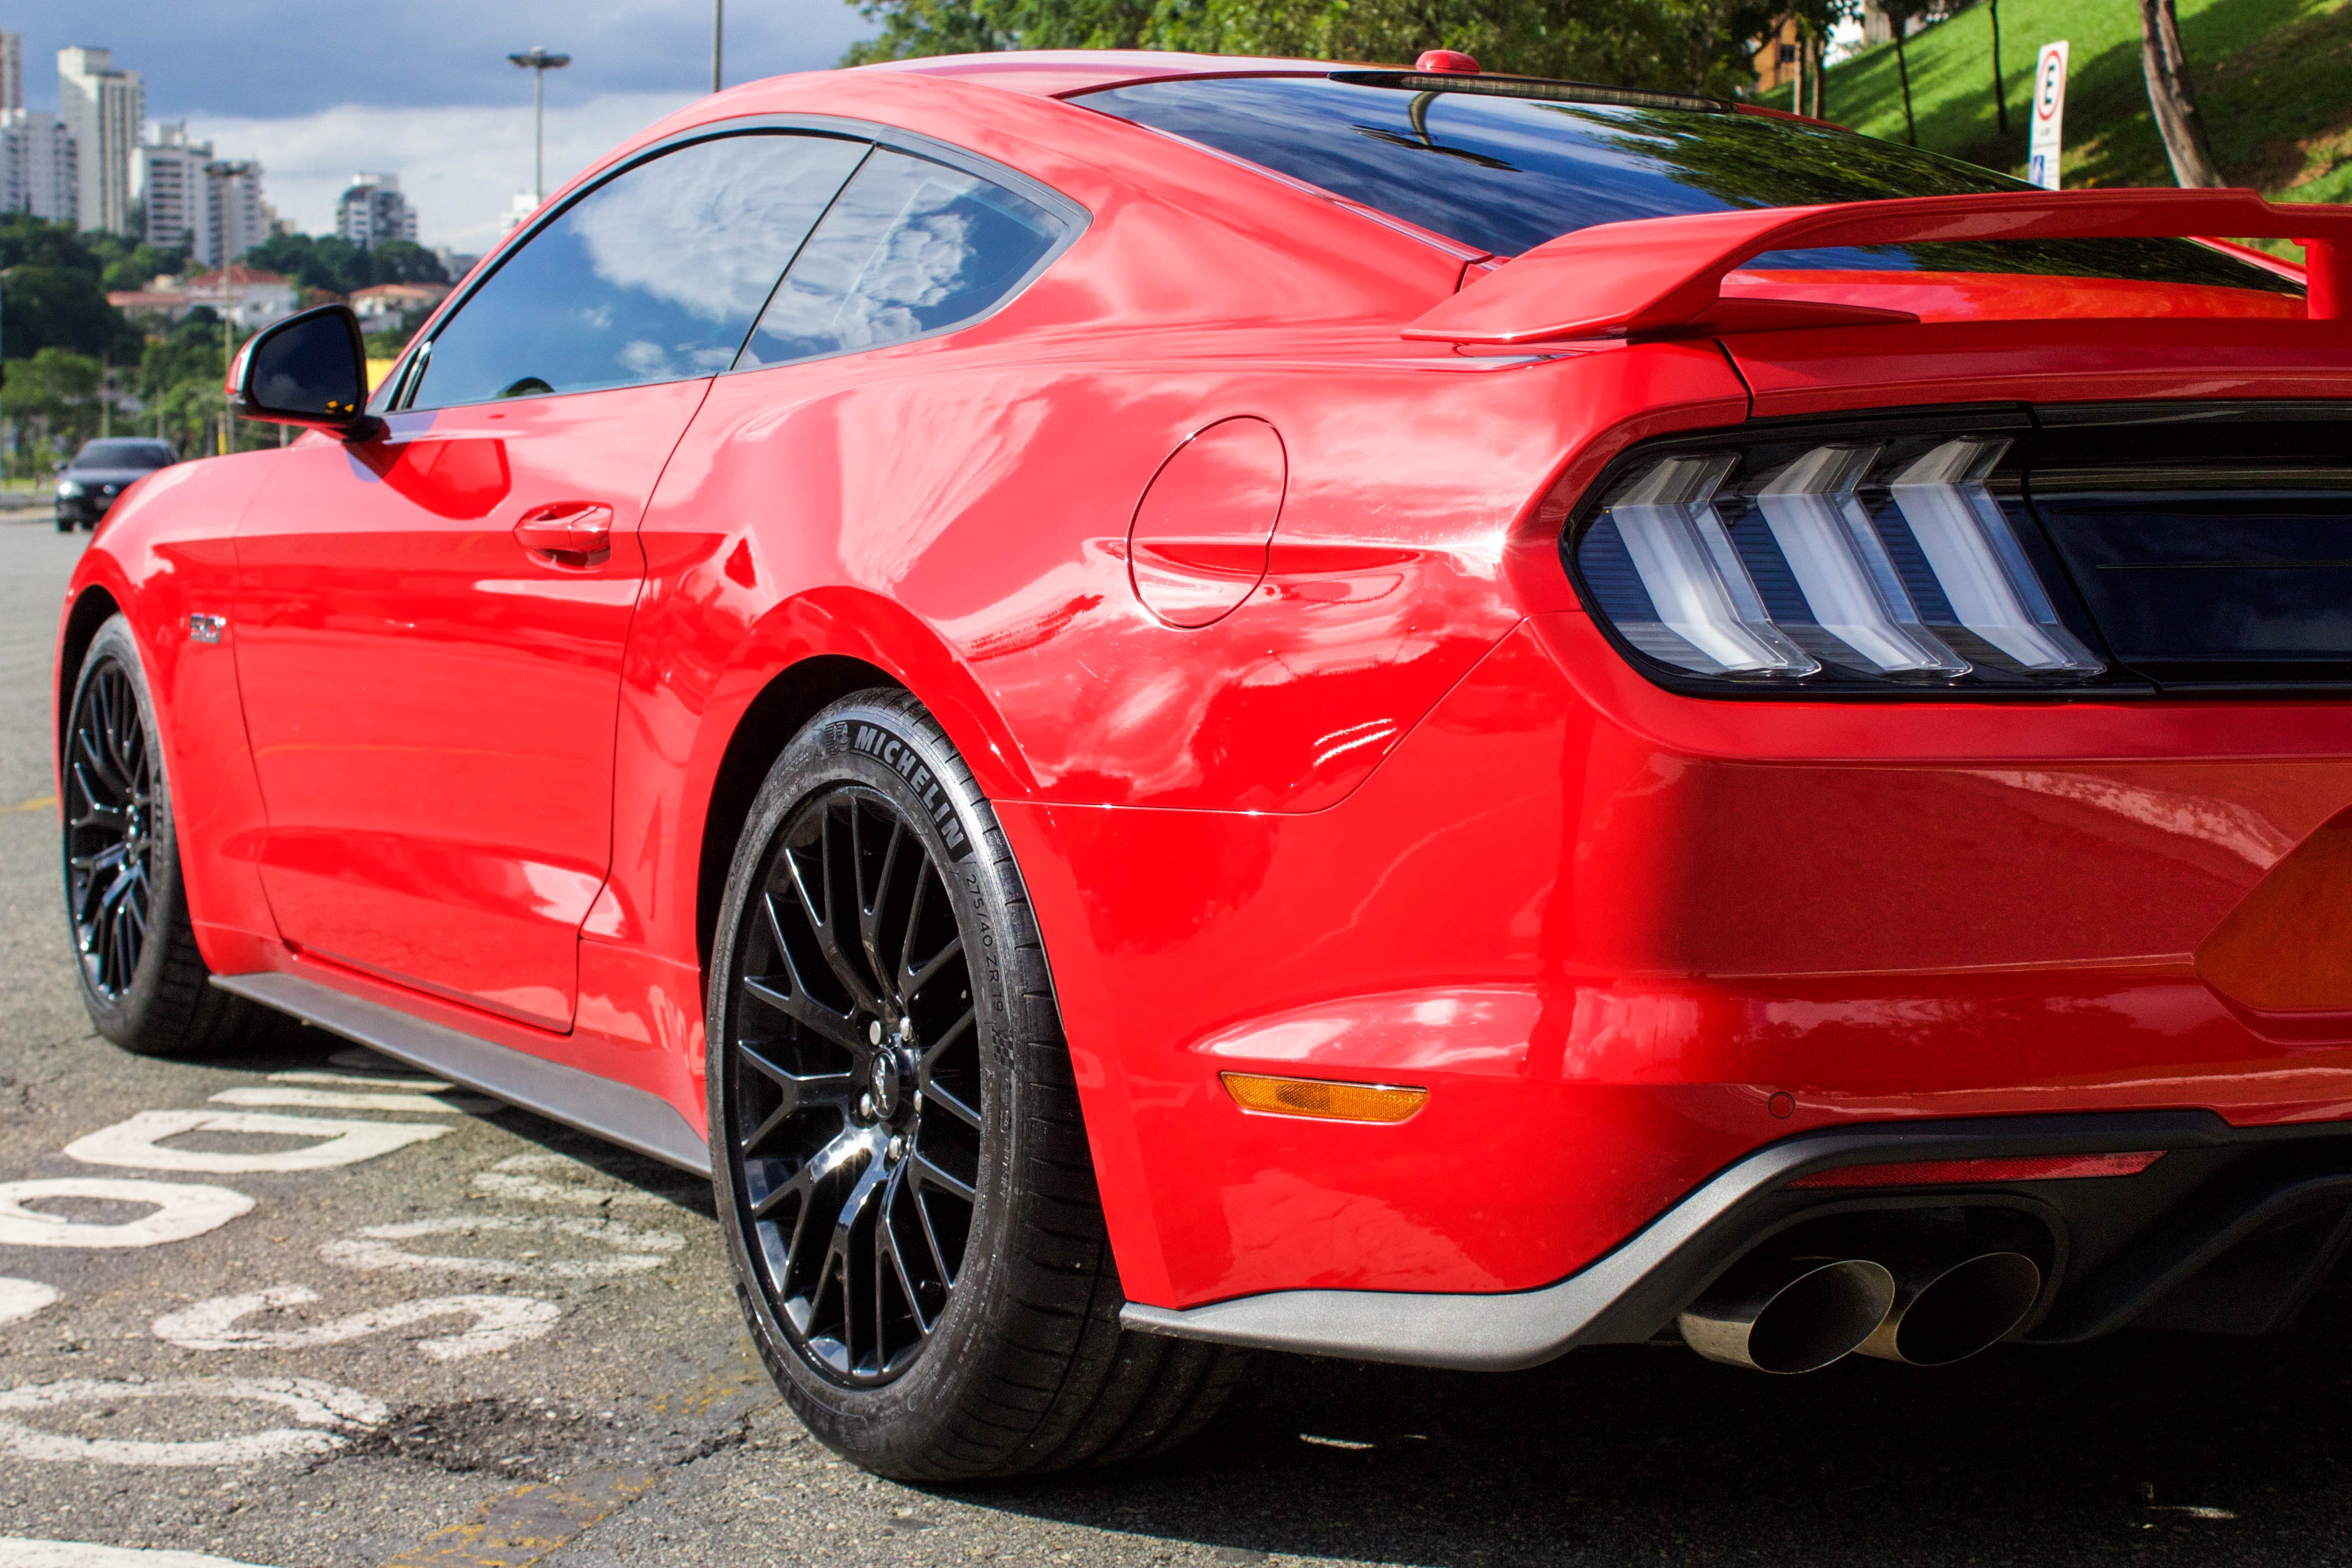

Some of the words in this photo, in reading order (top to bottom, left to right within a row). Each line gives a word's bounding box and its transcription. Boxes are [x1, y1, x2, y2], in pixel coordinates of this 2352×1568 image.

[2045, 65, 2056, 104] E
[854, 725, 965, 849] MICHELIN
[966, 874, 993, 947] 275/40
[986, 954, 999, 982] ZR
[992, 991, 1004, 1011] 19
